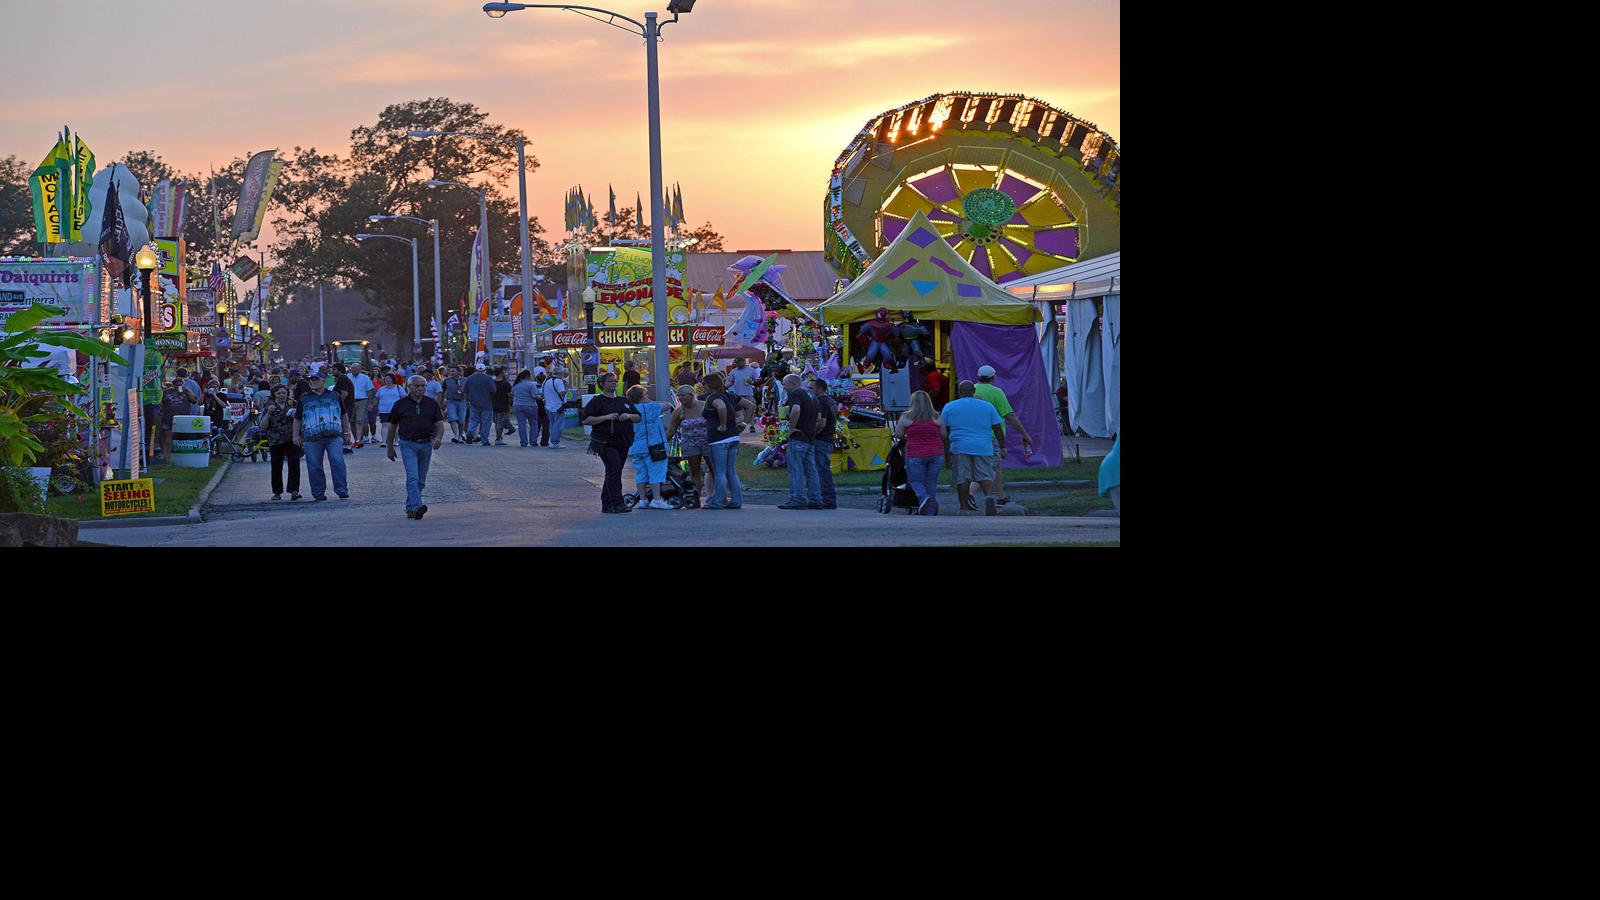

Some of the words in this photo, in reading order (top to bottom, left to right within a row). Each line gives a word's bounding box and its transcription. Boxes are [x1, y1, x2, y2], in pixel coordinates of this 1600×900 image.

[0, 270, 79, 286] Daiquiris
[599, 330, 644, 343] CHICKEN
[693, 329, 722, 342] Coca-Cola
[104, 482, 134, 493] START
[104, 489, 151, 500] SEEING
